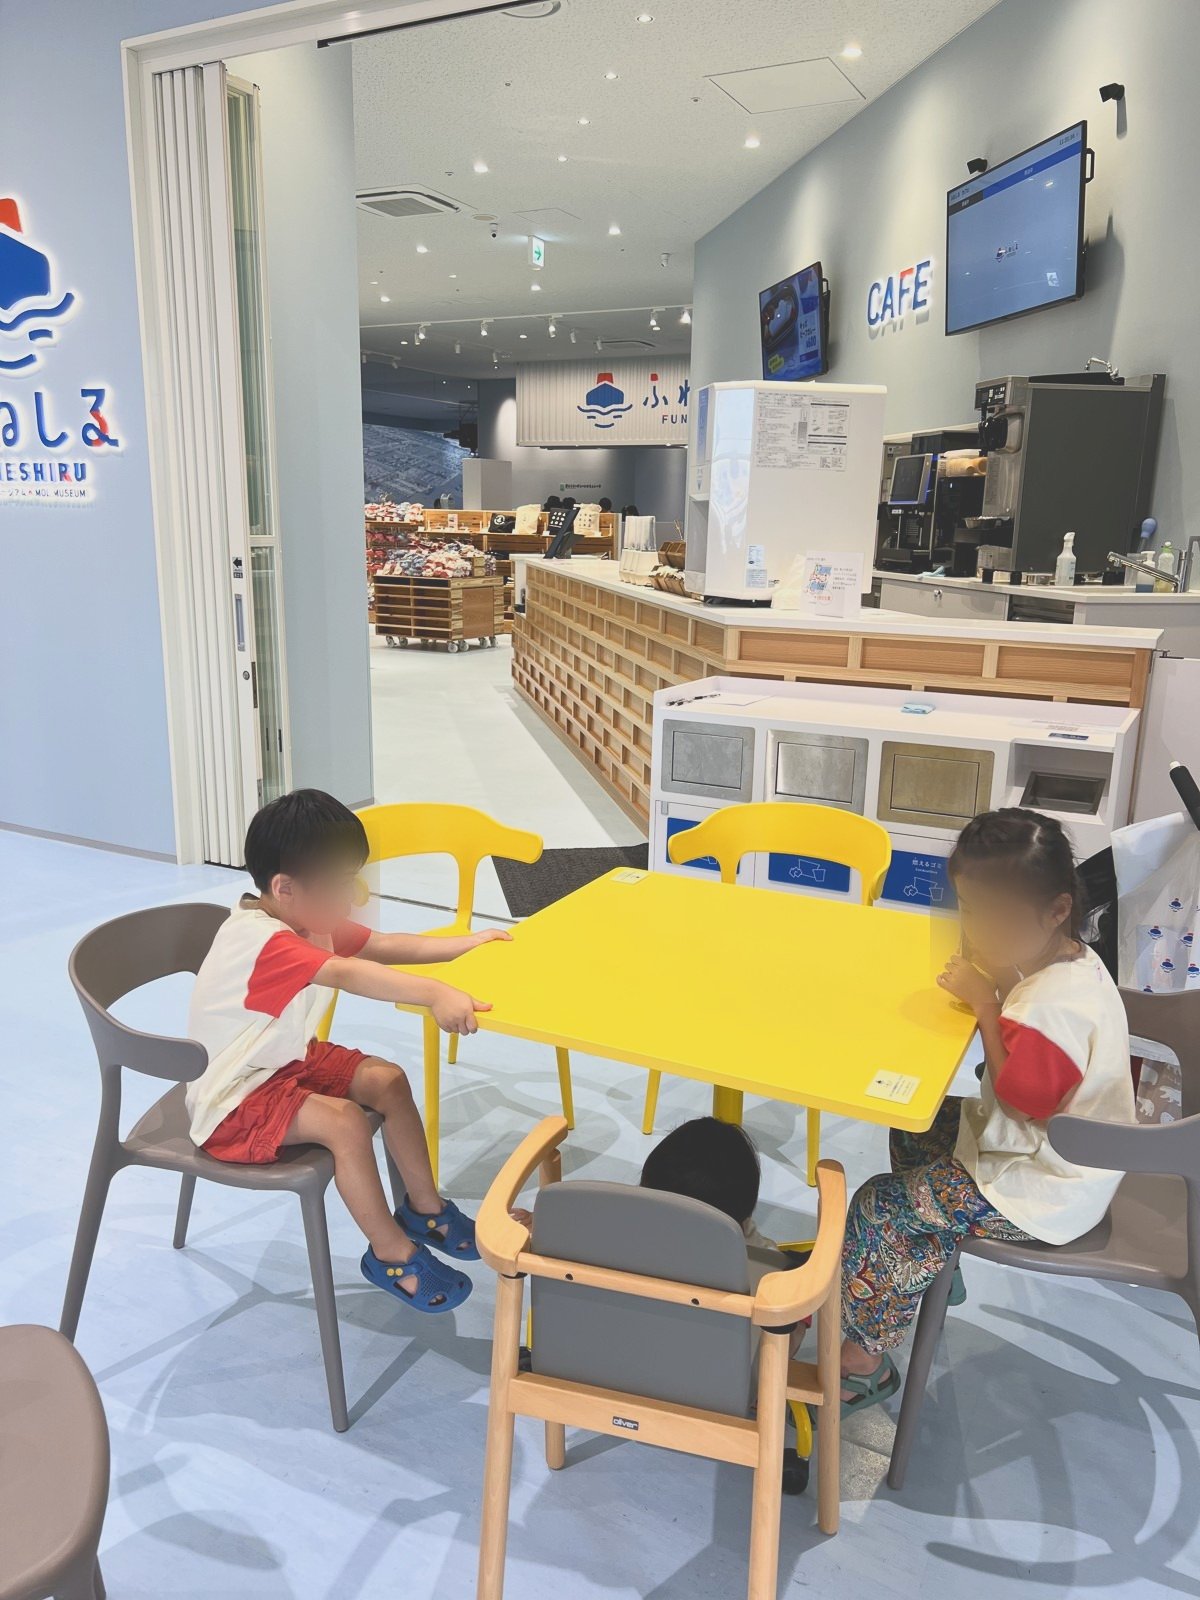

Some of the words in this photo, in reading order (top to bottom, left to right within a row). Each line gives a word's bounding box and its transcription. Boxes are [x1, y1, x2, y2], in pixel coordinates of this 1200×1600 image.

[867, 260, 930, 325] CAFE
[661, 414, 688, 424] FUN
[0, 462, 87, 482] ESHIRU
[613, 1418, 638, 1428] oliver
